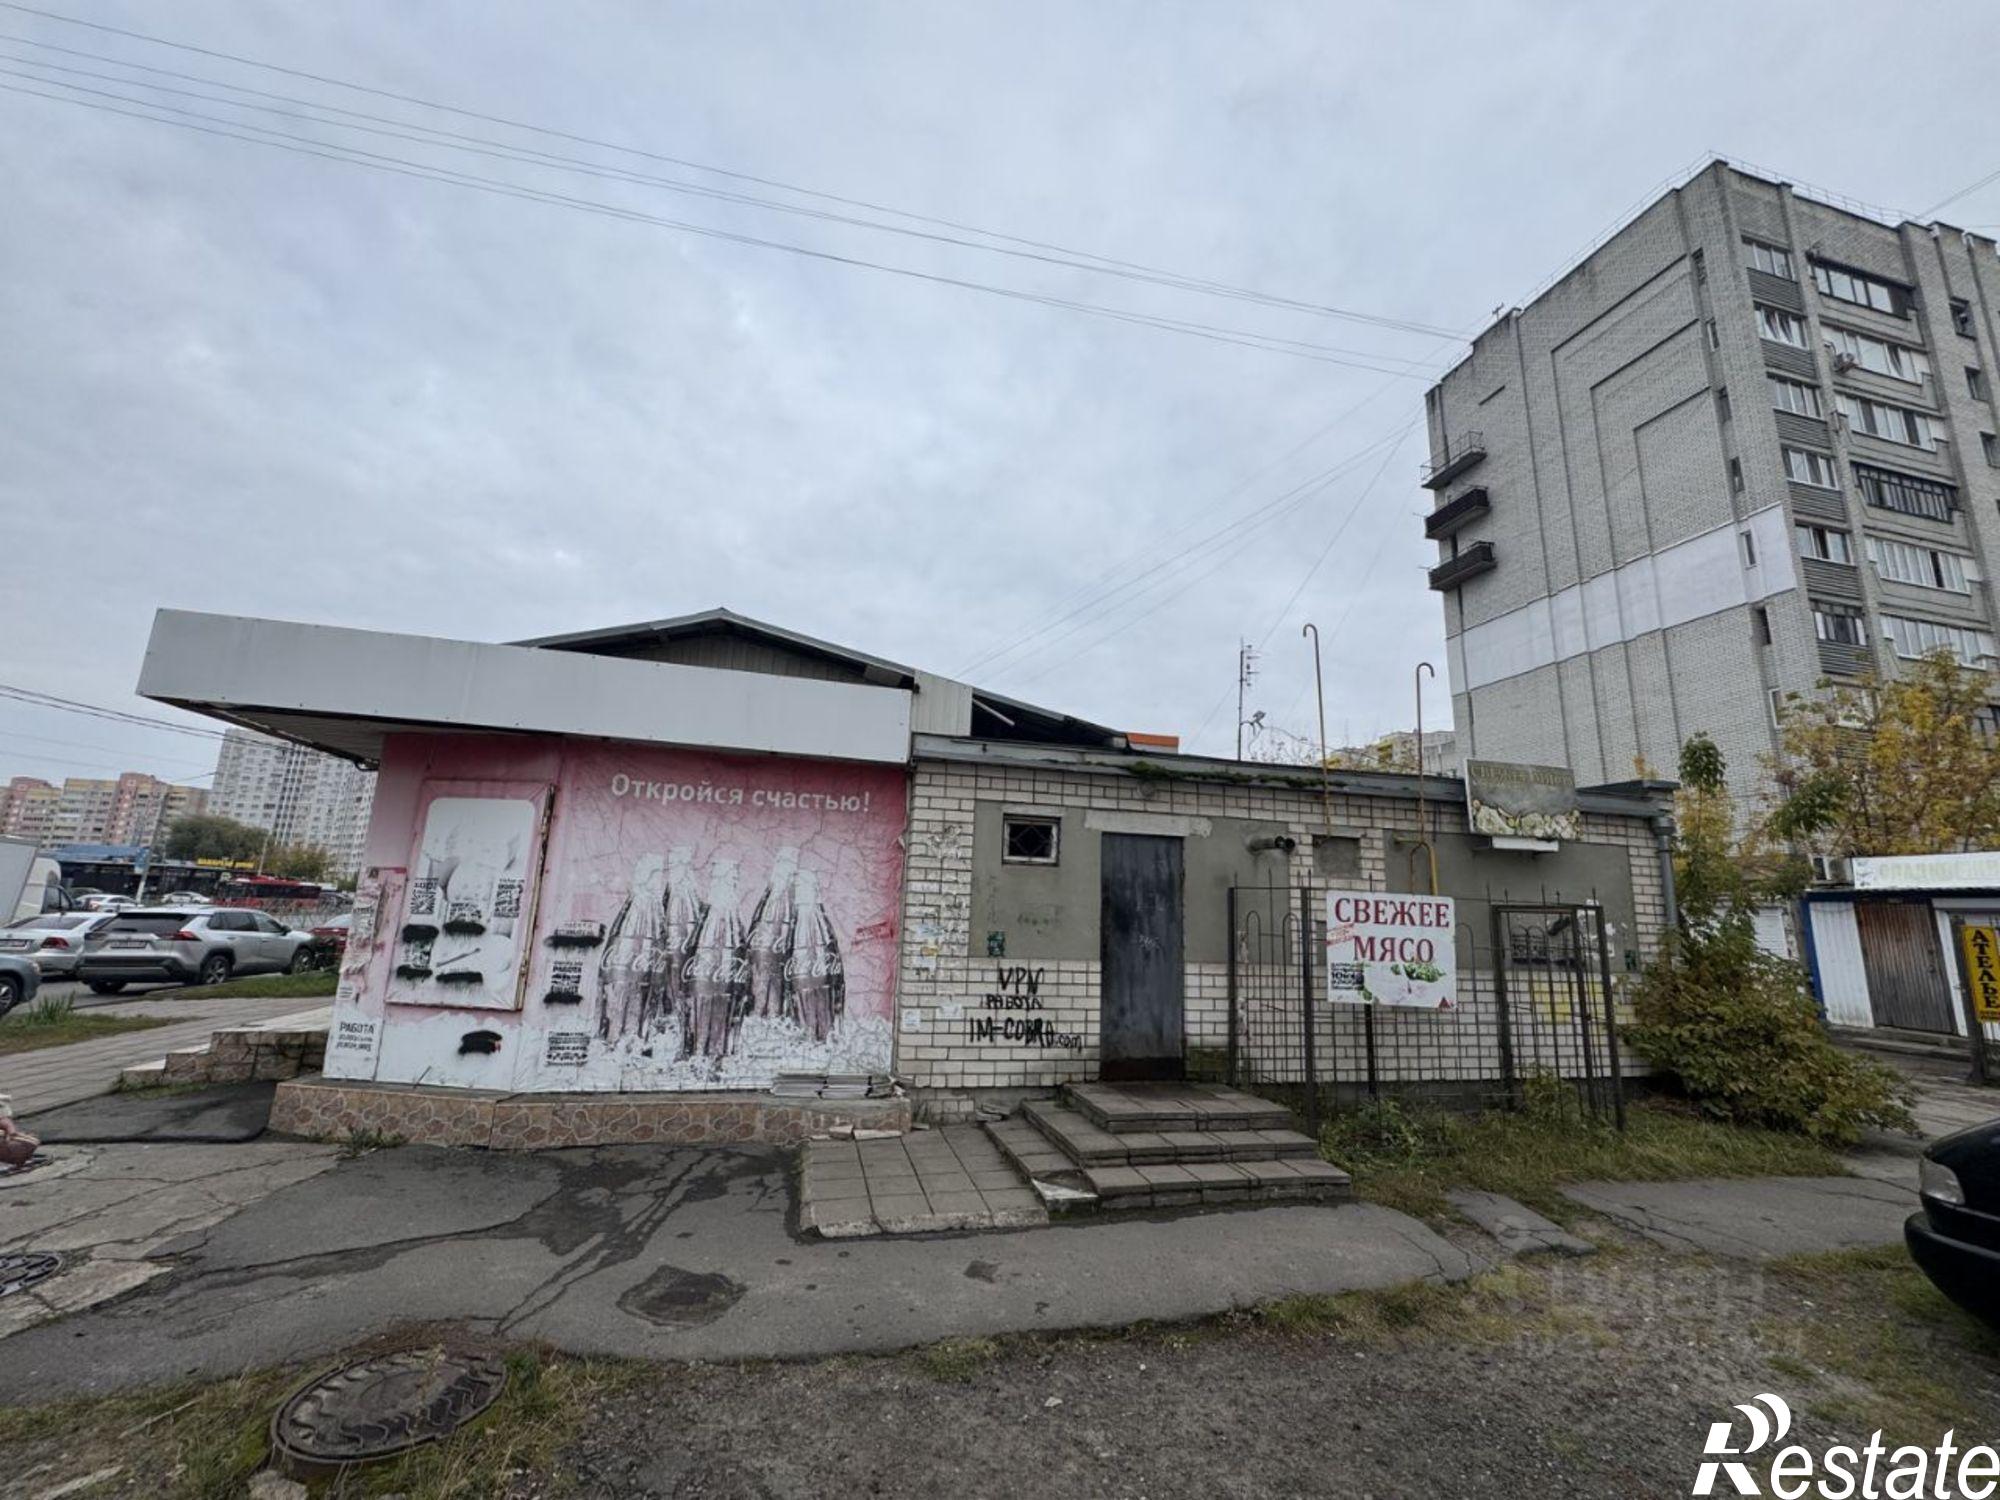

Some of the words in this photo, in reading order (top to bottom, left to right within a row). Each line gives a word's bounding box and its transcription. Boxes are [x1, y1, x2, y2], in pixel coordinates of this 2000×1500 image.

[611, 773, 744, 805] Откройся
[752, 789, 870, 813] счастью!
[1334, 897, 1450, 928] СВЕЖЕЕ
[1352, 935, 1434, 963] МЯСО
[999, 966, 1045, 996] VPN
[1971, 929, 2000, 1010] АТЕЛЬЕ
[339, 1021, 375, 1035] РАБОТА
